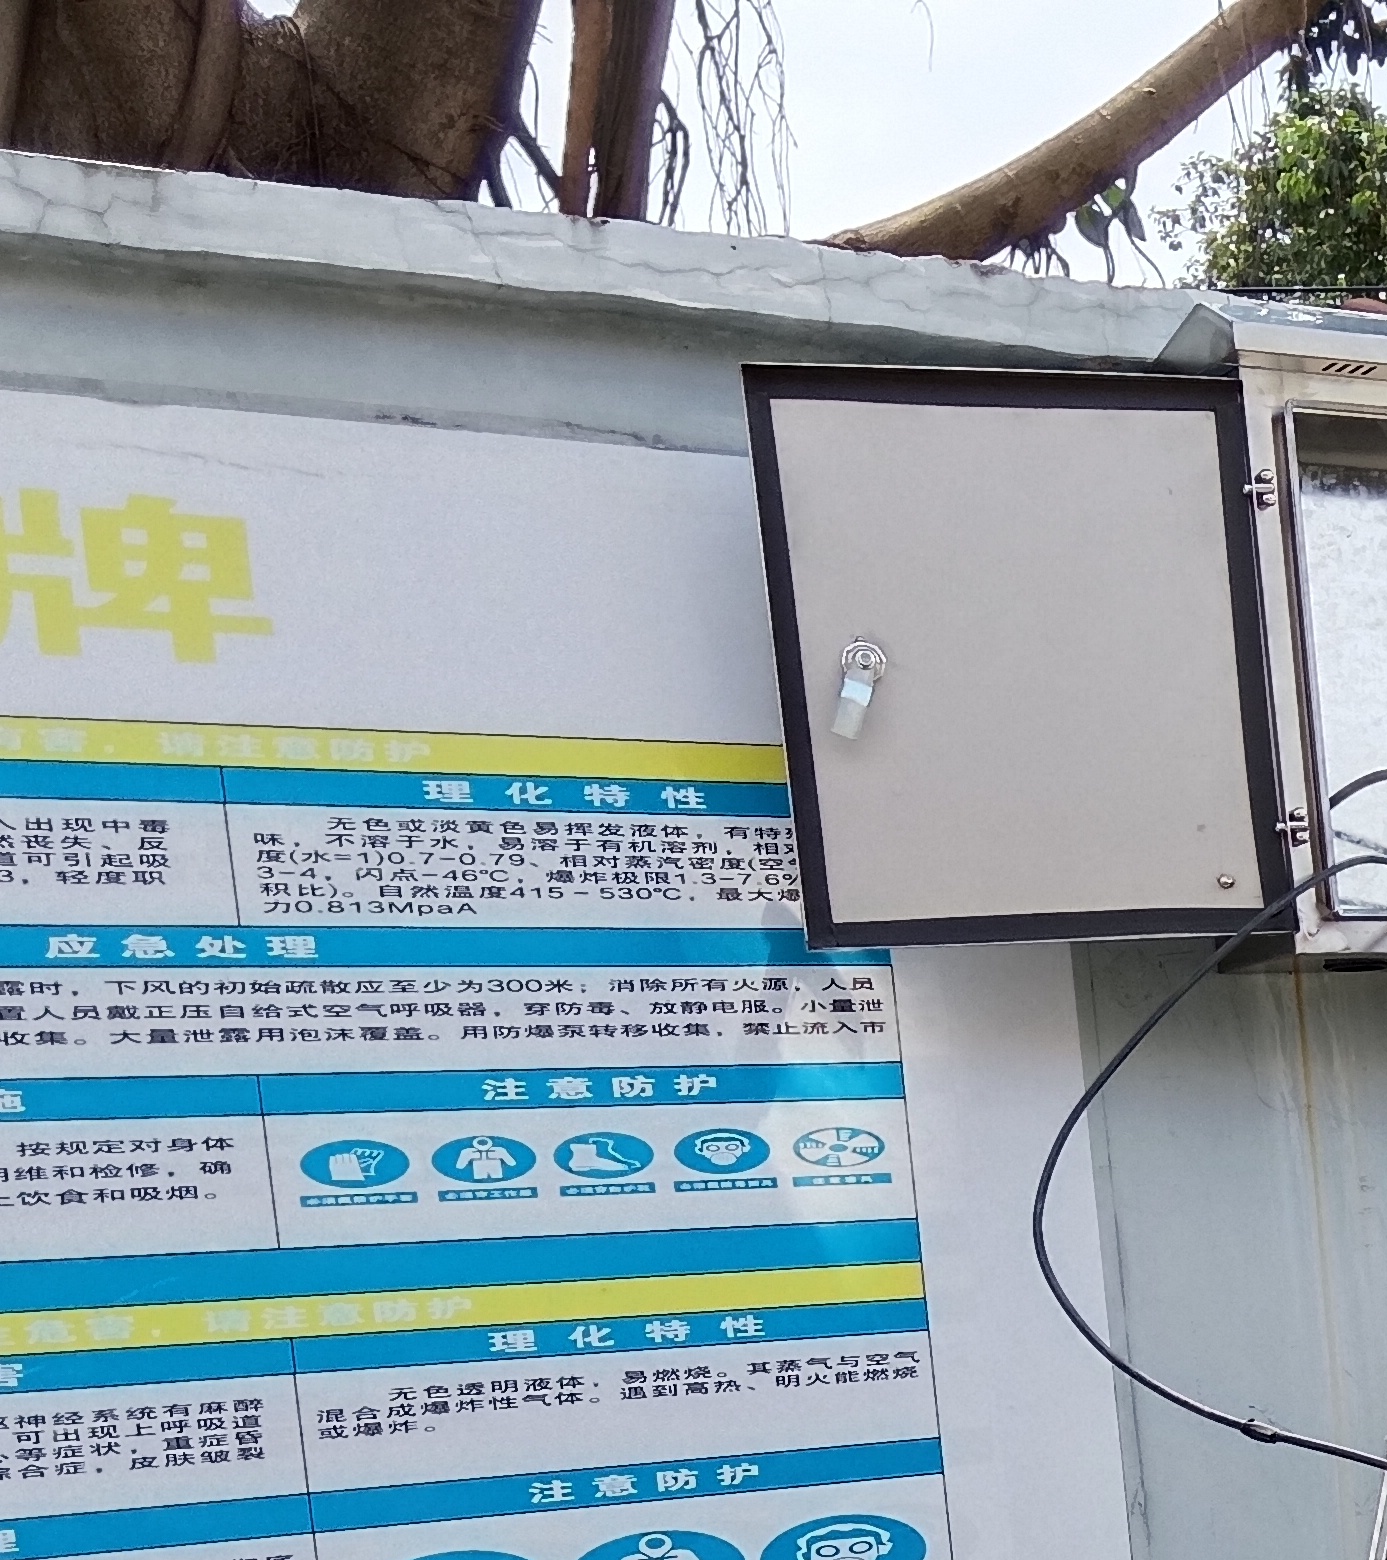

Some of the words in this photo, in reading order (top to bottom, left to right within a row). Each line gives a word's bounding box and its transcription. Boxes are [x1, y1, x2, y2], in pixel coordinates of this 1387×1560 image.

[422, 780, 707, 809] 理化特性
[45, 934, 319, 959] 应急处理
[482, 1074, 718, 1101] 注意防护
[16, 1136, 235, 1157] 按规定对身体
[488, 1315, 766, 1352] 理化特性
[12, 1415, 262, 1444] 可出现上呼吸道
[530, 1463, 761, 1503] 注意防护
